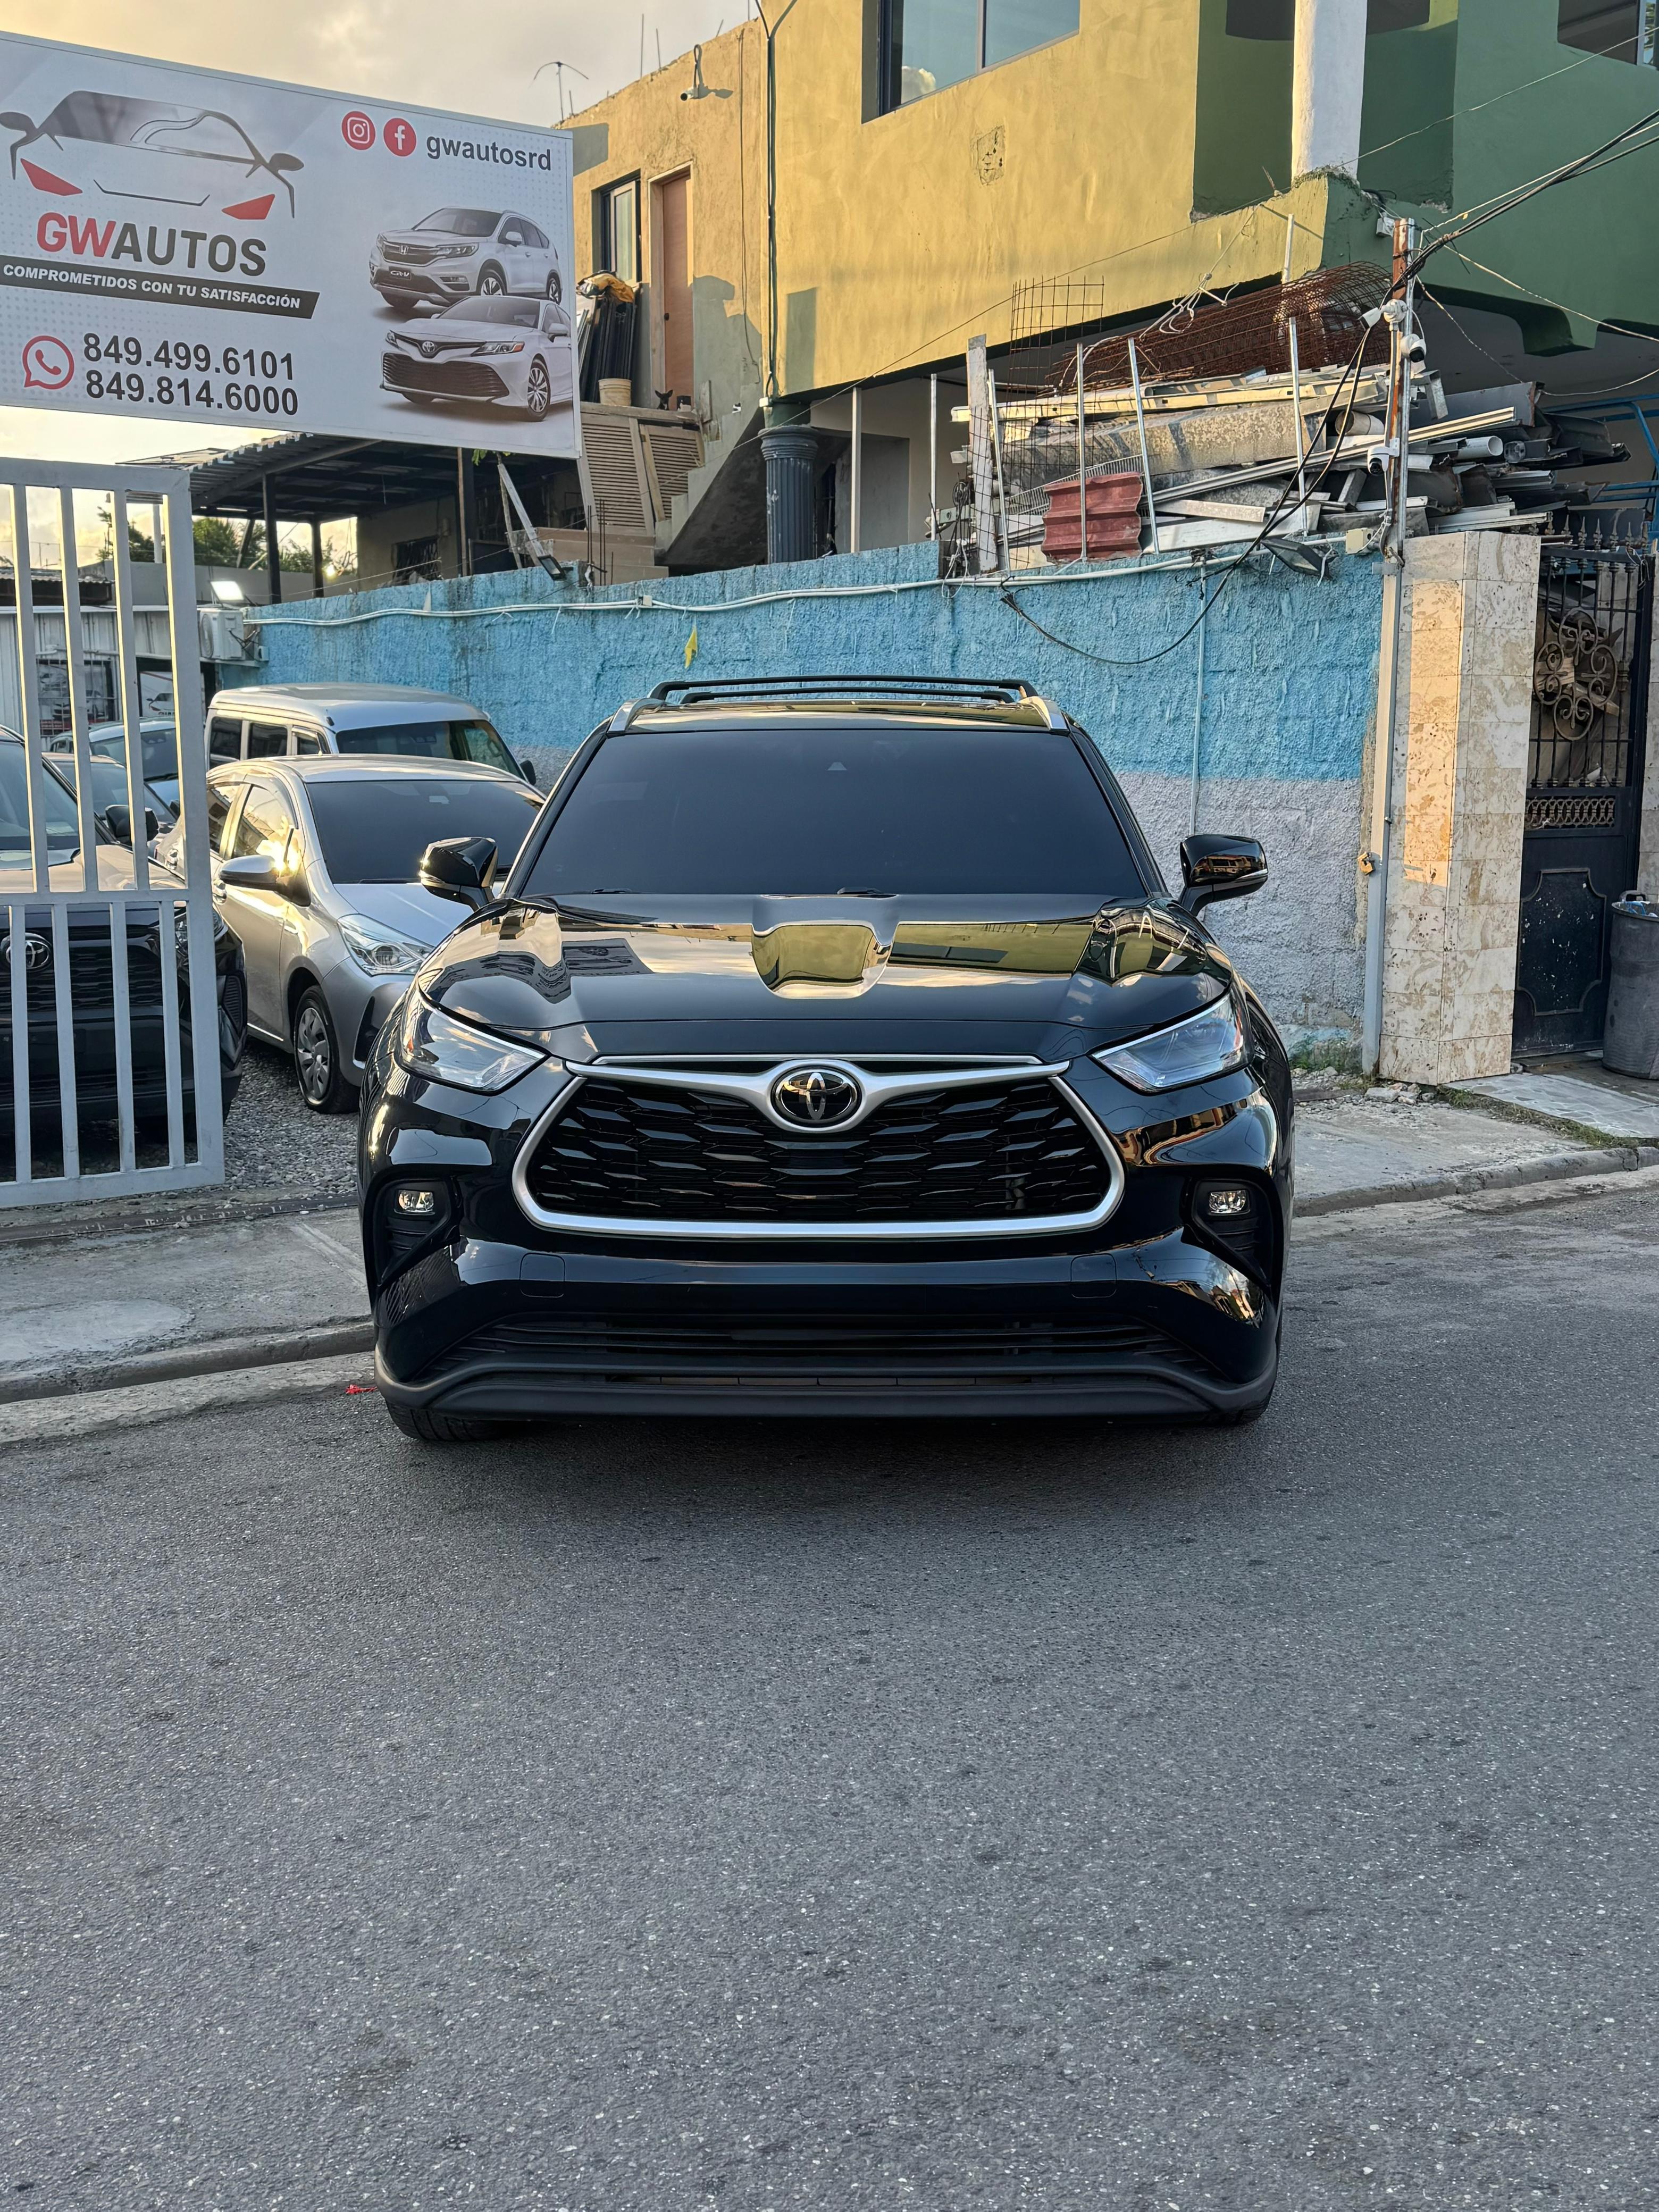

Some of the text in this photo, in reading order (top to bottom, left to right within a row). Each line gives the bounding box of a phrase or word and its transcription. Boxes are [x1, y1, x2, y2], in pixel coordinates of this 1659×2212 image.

[426, 136, 551, 171] gwautosrd
[37, 212, 266, 276] GWAUTOS
[3, 264, 300, 308] COMPROMETIDOS CON TU SATISFACCIÓN
[83, 333, 294, 380] 849.499.6101
[86, 370, 298, 415] 849.814.6000
